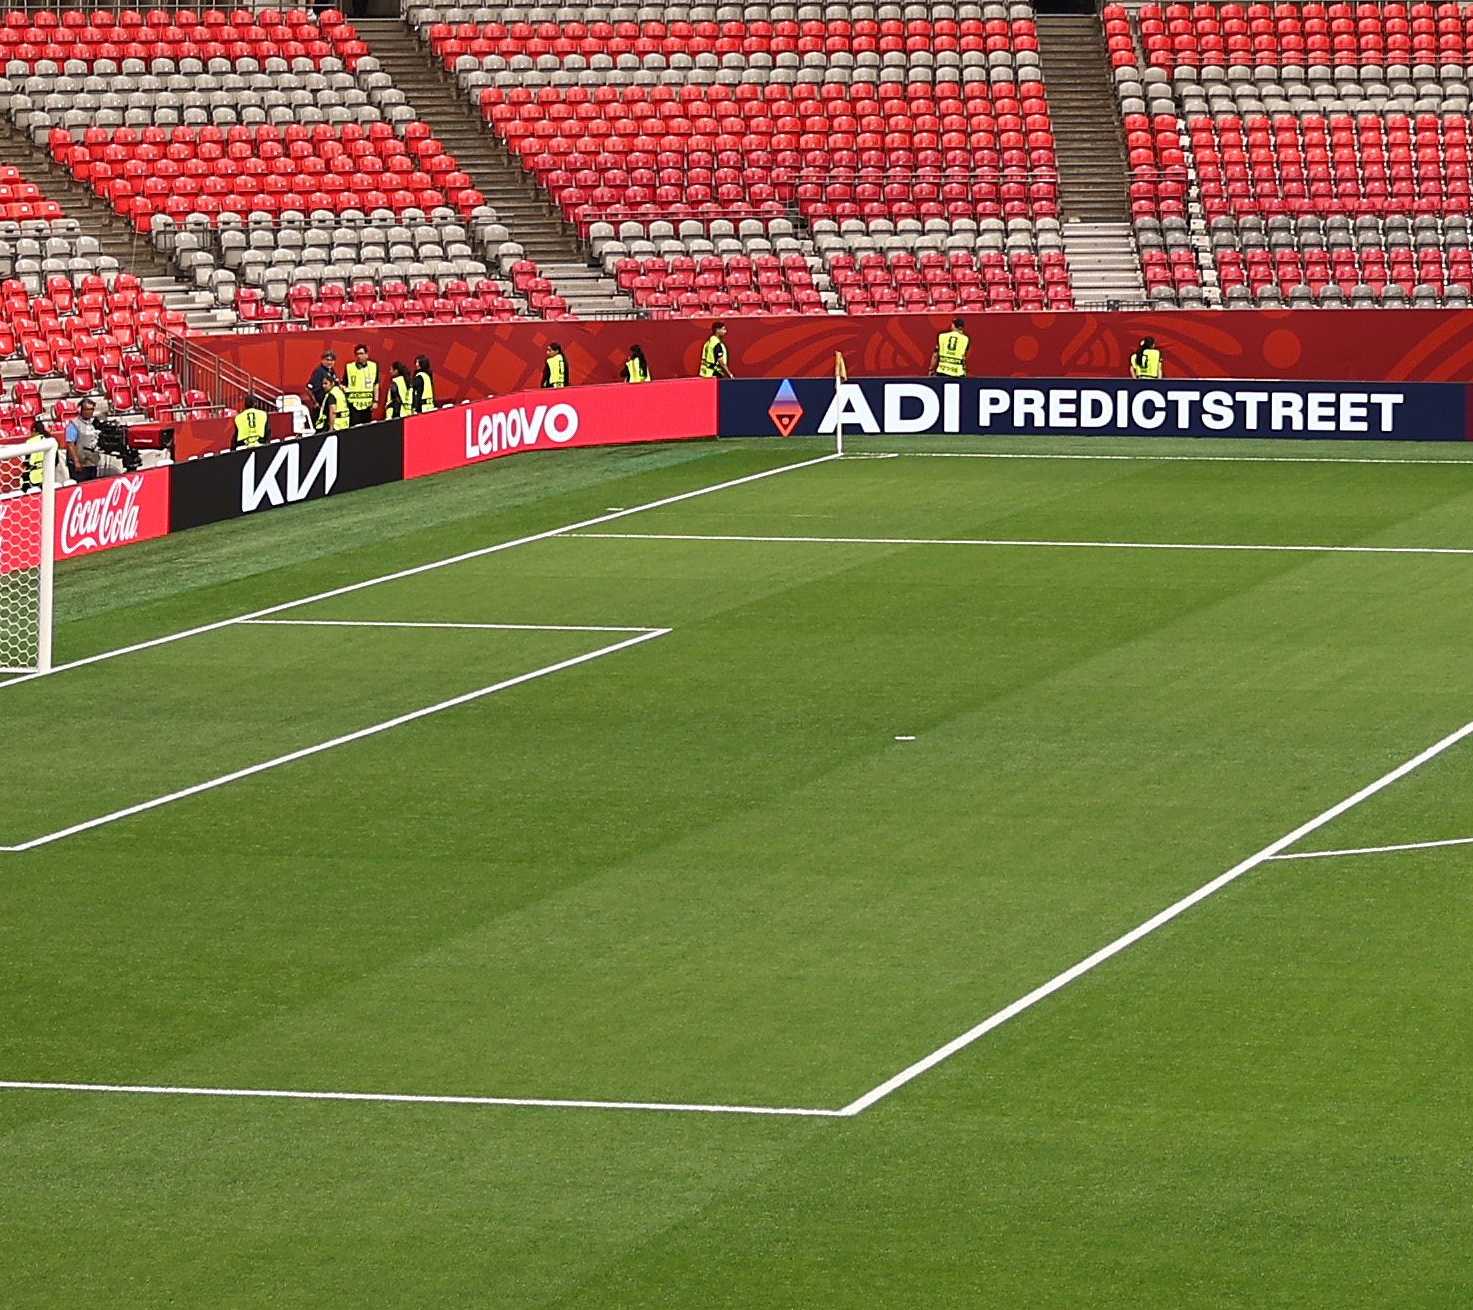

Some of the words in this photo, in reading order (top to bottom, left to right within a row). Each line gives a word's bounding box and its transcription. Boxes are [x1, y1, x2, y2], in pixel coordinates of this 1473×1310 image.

[466, 403, 579, 459] Lenovo
[817, 382, 960, 434] ADI
[979, 389, 1404, 433] PREDICTSTREET
[241, 434, 338, 513] KIA
[61, 475, 145, 554] Coca-Cola
